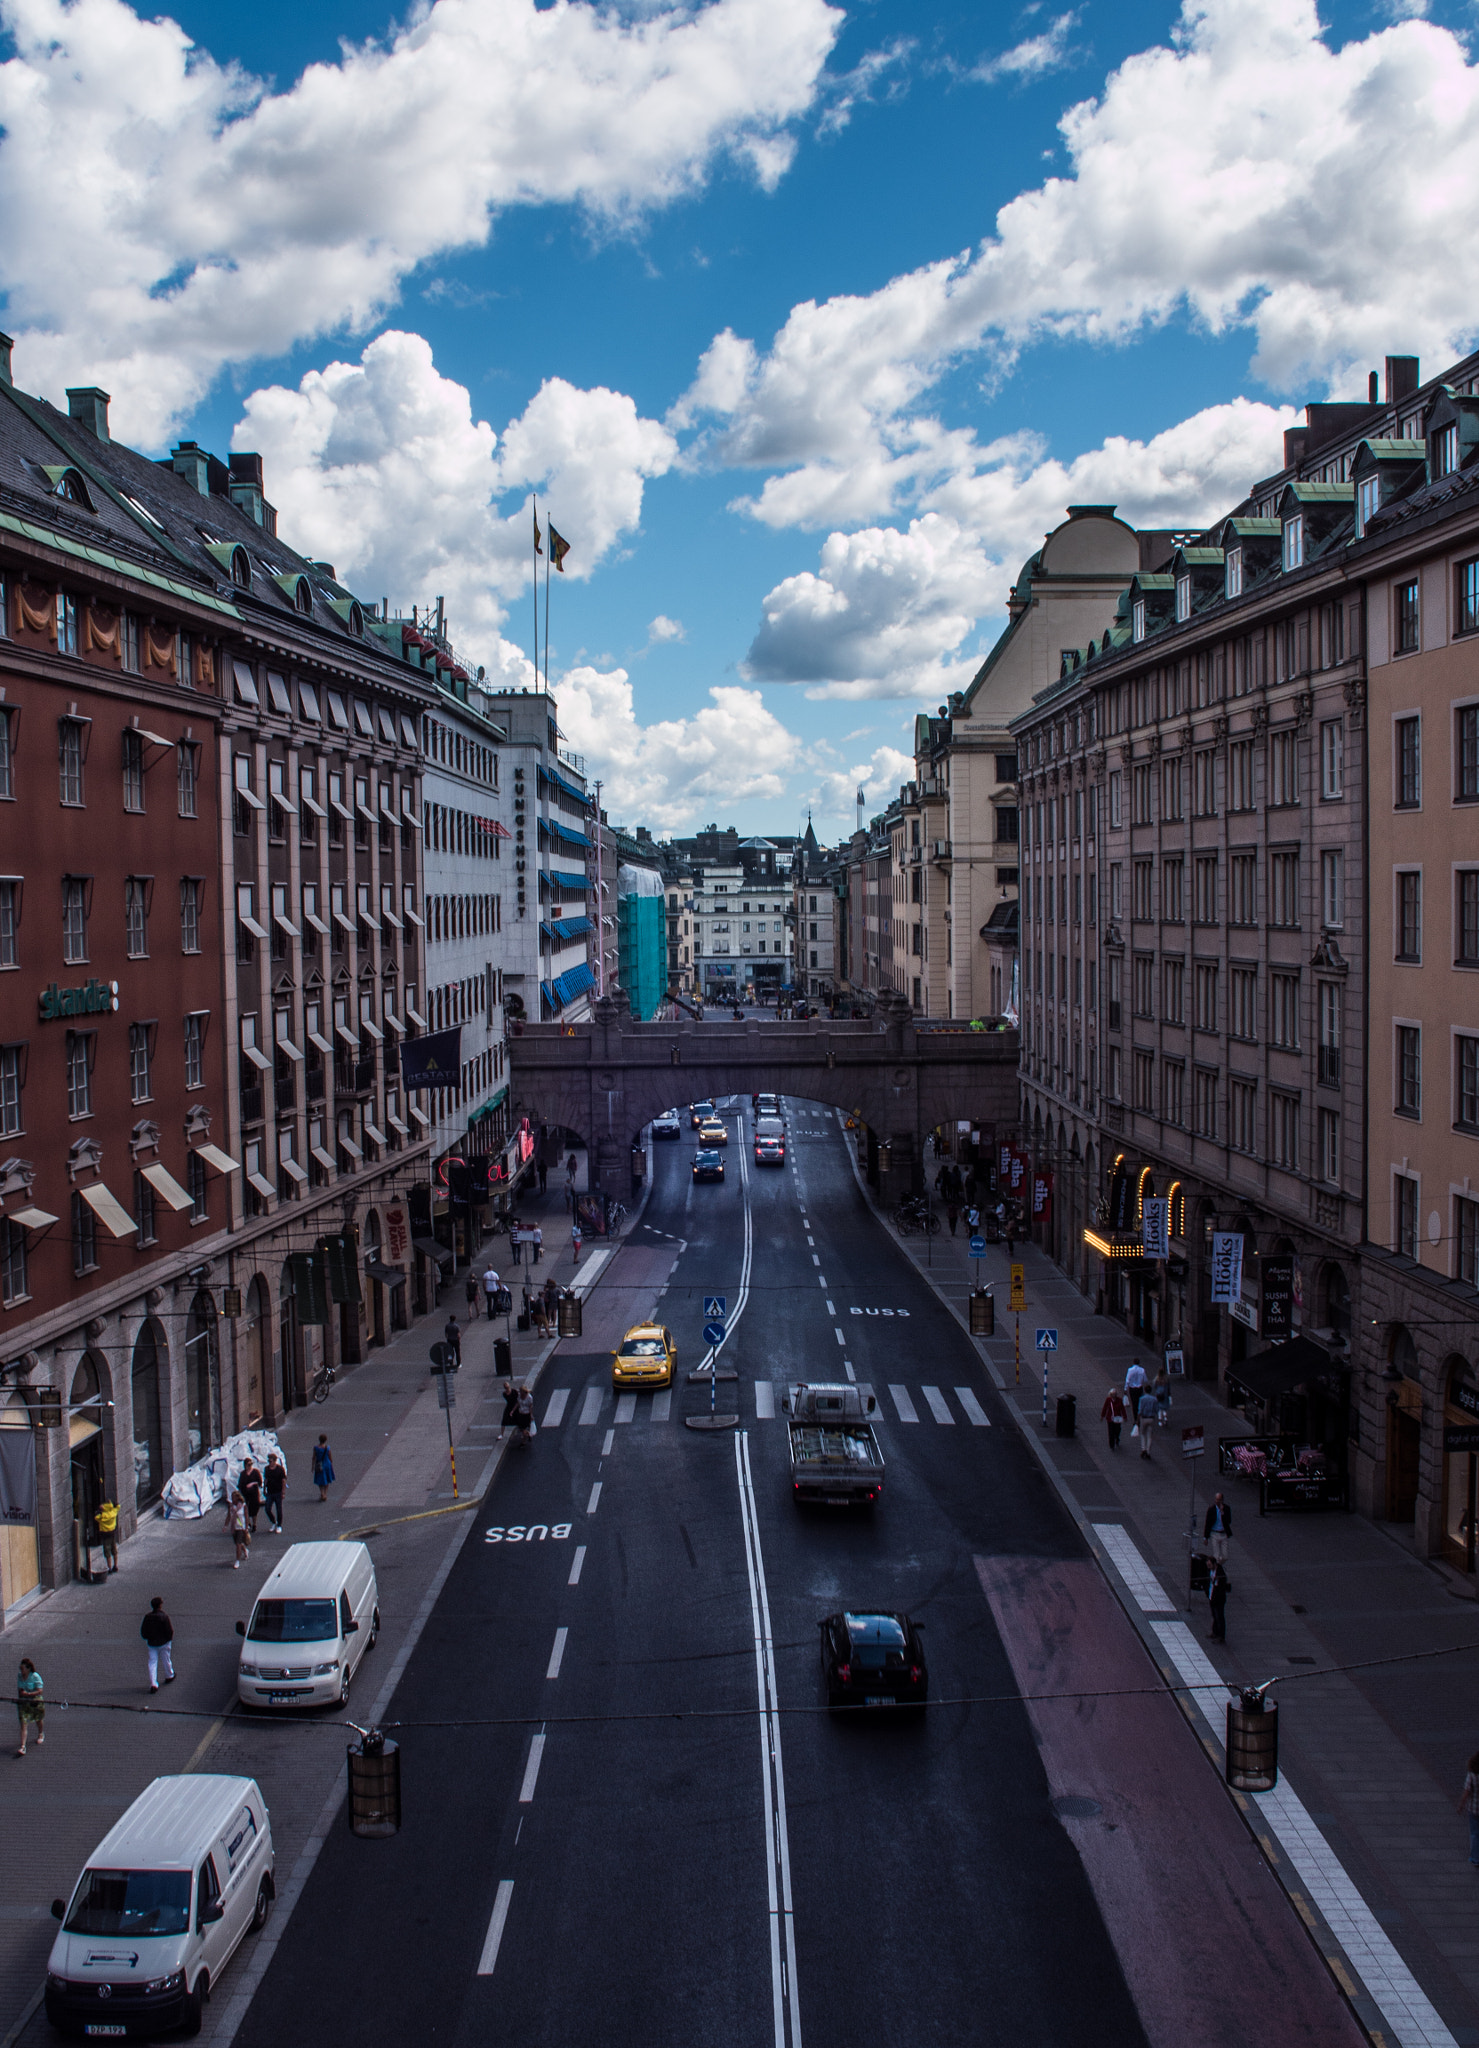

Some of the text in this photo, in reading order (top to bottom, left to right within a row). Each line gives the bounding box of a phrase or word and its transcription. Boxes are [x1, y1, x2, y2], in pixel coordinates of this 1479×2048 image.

[514, 768, 525, 917] KUNGSHUSET
[1000, 1146, 1012, 1175] siba
[1011, 1158, 1024, 1188] siba
[1034, 1179, 1049, 1213] siba
[1146, 1203, 1160, 1253] Hööks
[1214, 1238, 1233, 1296] Hööks
[850, 1307, 910, 1316] BUSS
[1267, 1316, 1285, 1324] THAI
[1271, 1301, 1281, 1314] &
[484, 1523, 573, 1543] BUSS
